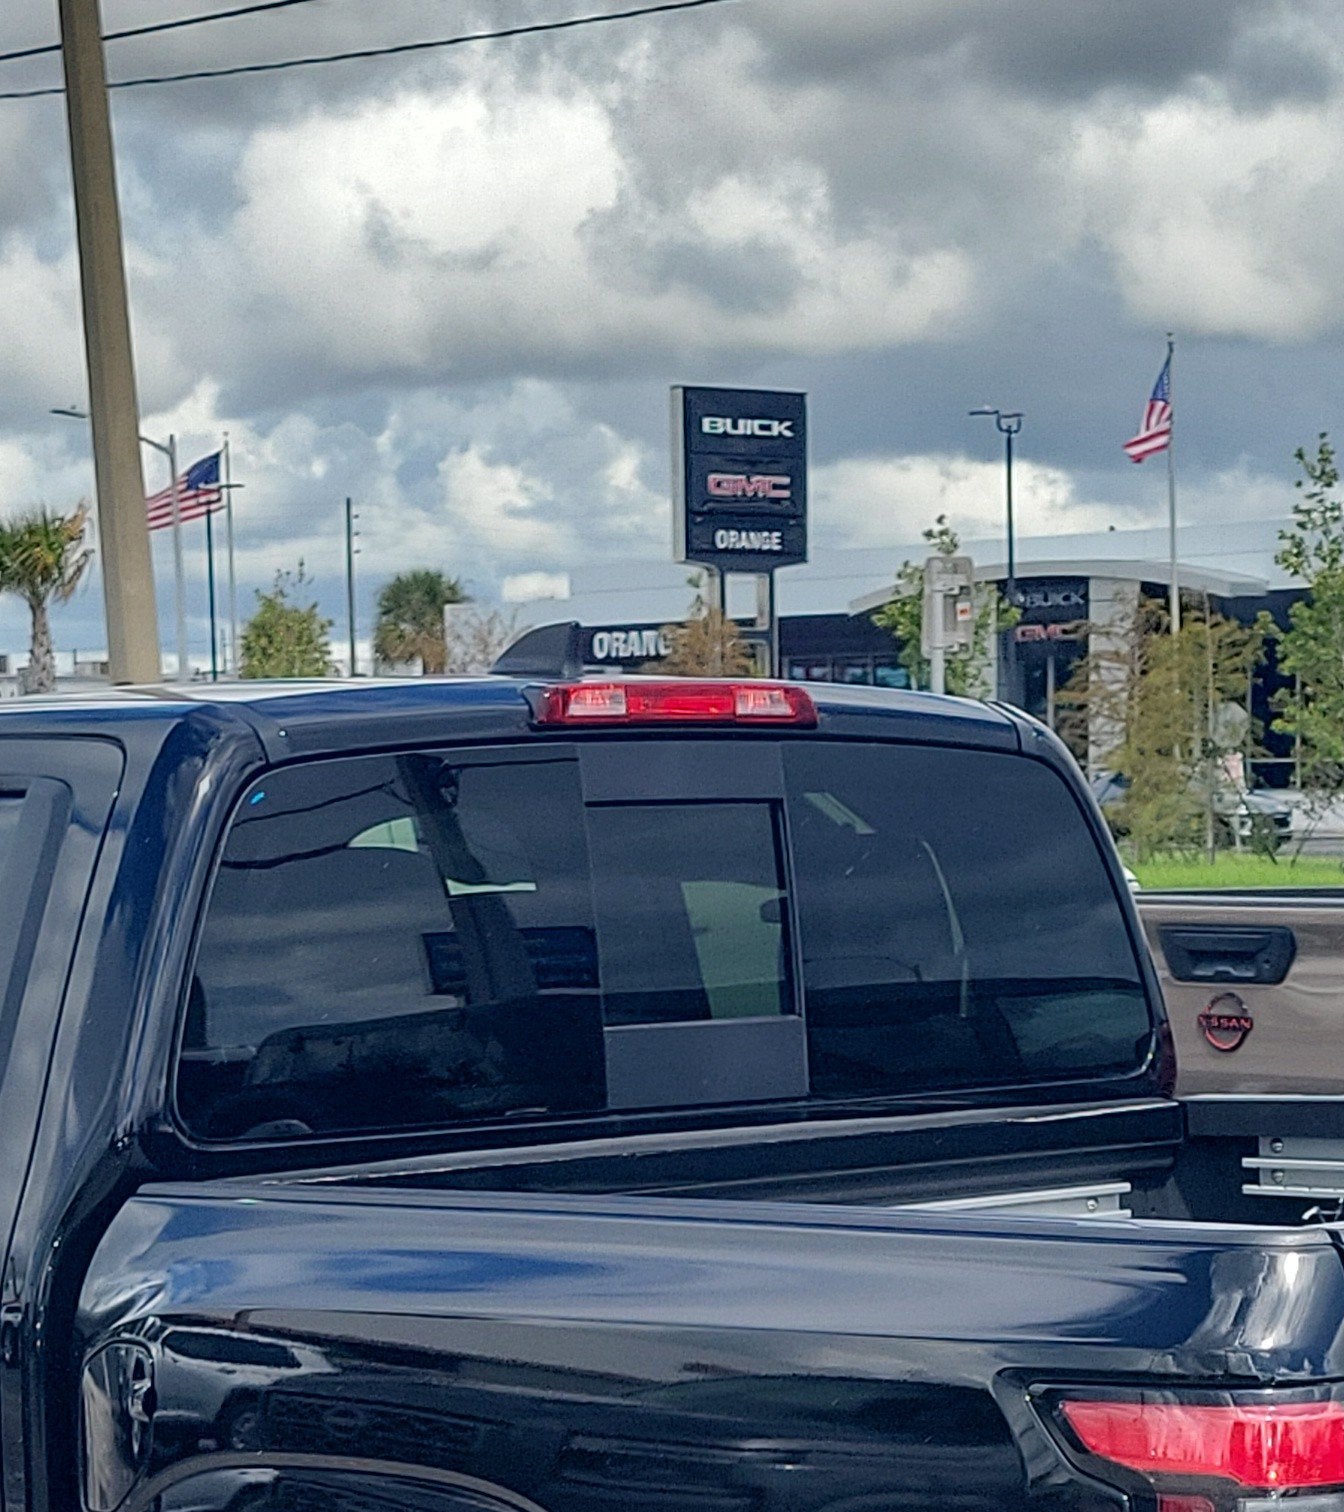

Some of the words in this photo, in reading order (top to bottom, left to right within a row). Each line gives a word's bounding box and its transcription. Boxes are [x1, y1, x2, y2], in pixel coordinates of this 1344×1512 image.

[702, 416, 795, 437] BUICK
[707, 473, 791, 498] GMC
[714, 529, 782, 549] ORANGE
[1024, 585, 1087, 608] BUICK
[1015, 622, 1086, 642] GMC
